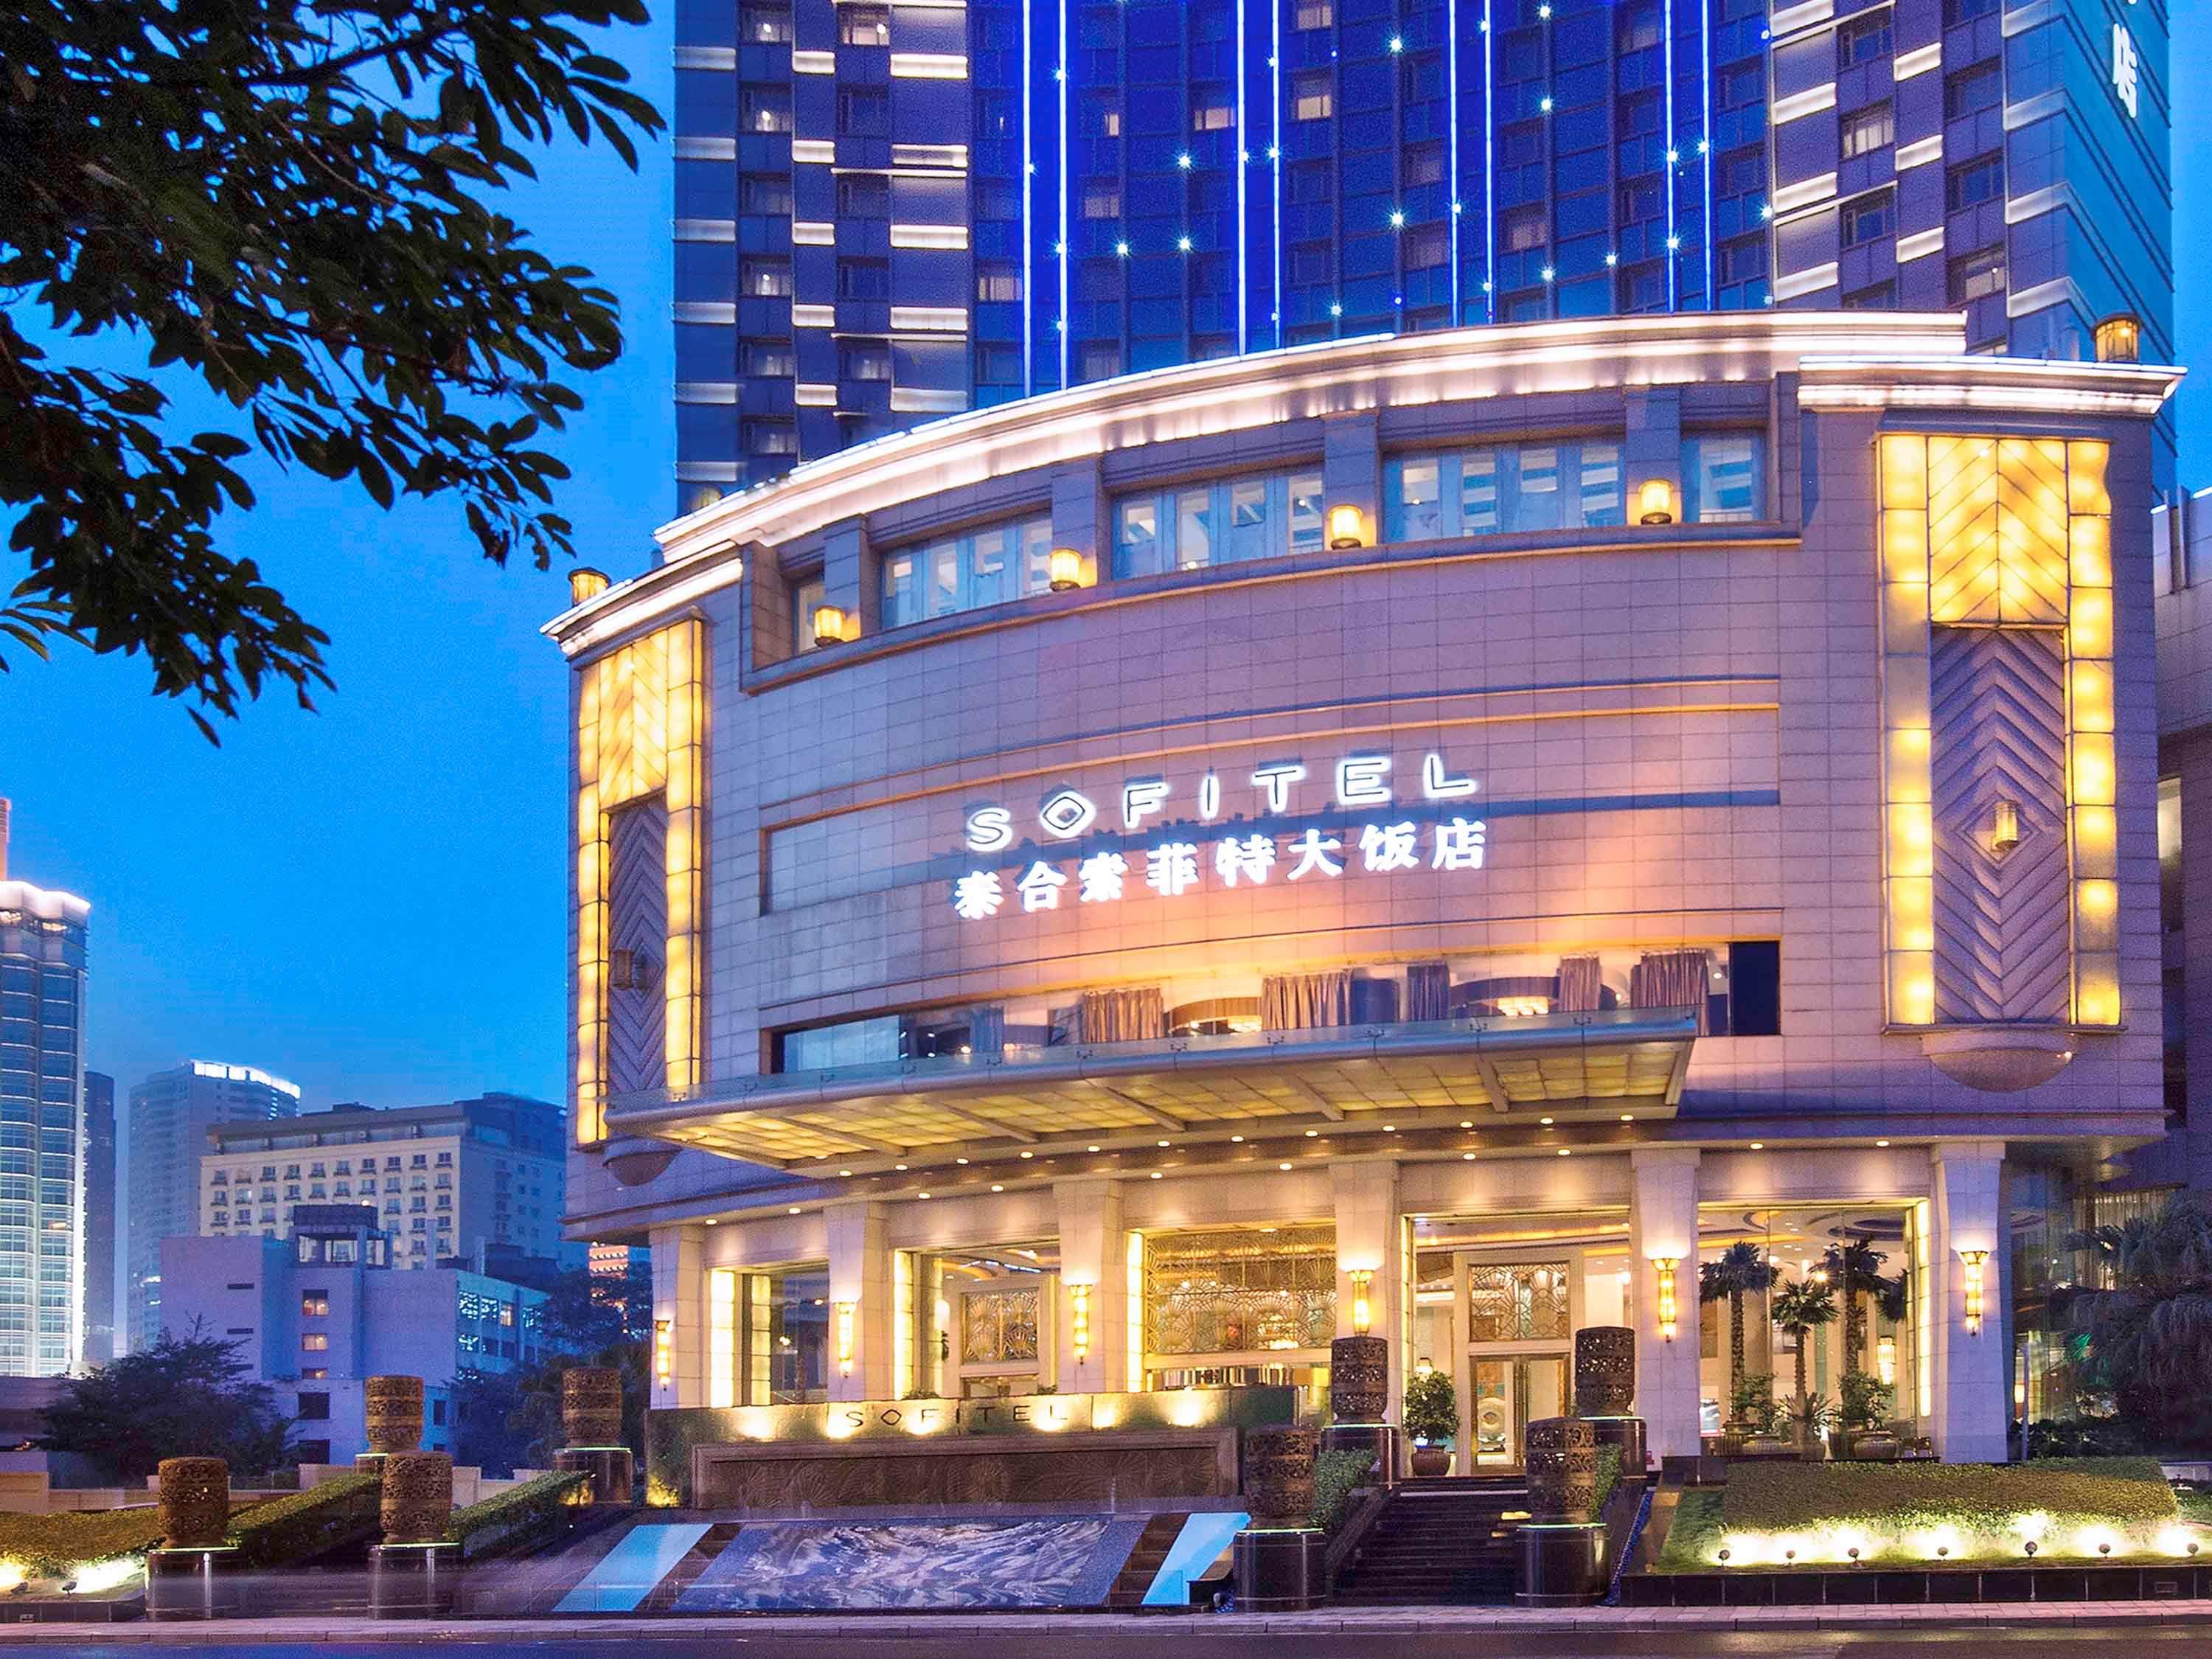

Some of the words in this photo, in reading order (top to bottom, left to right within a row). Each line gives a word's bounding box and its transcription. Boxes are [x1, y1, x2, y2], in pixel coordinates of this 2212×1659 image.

[2112, 0, 2138, 119] 店
[967, 754, 1478, 852] SOFITEL
[954, 817, 1487, 920] 泰合索菲特大饭店
[846, 1405, 1068, 1427] SOFITEL
